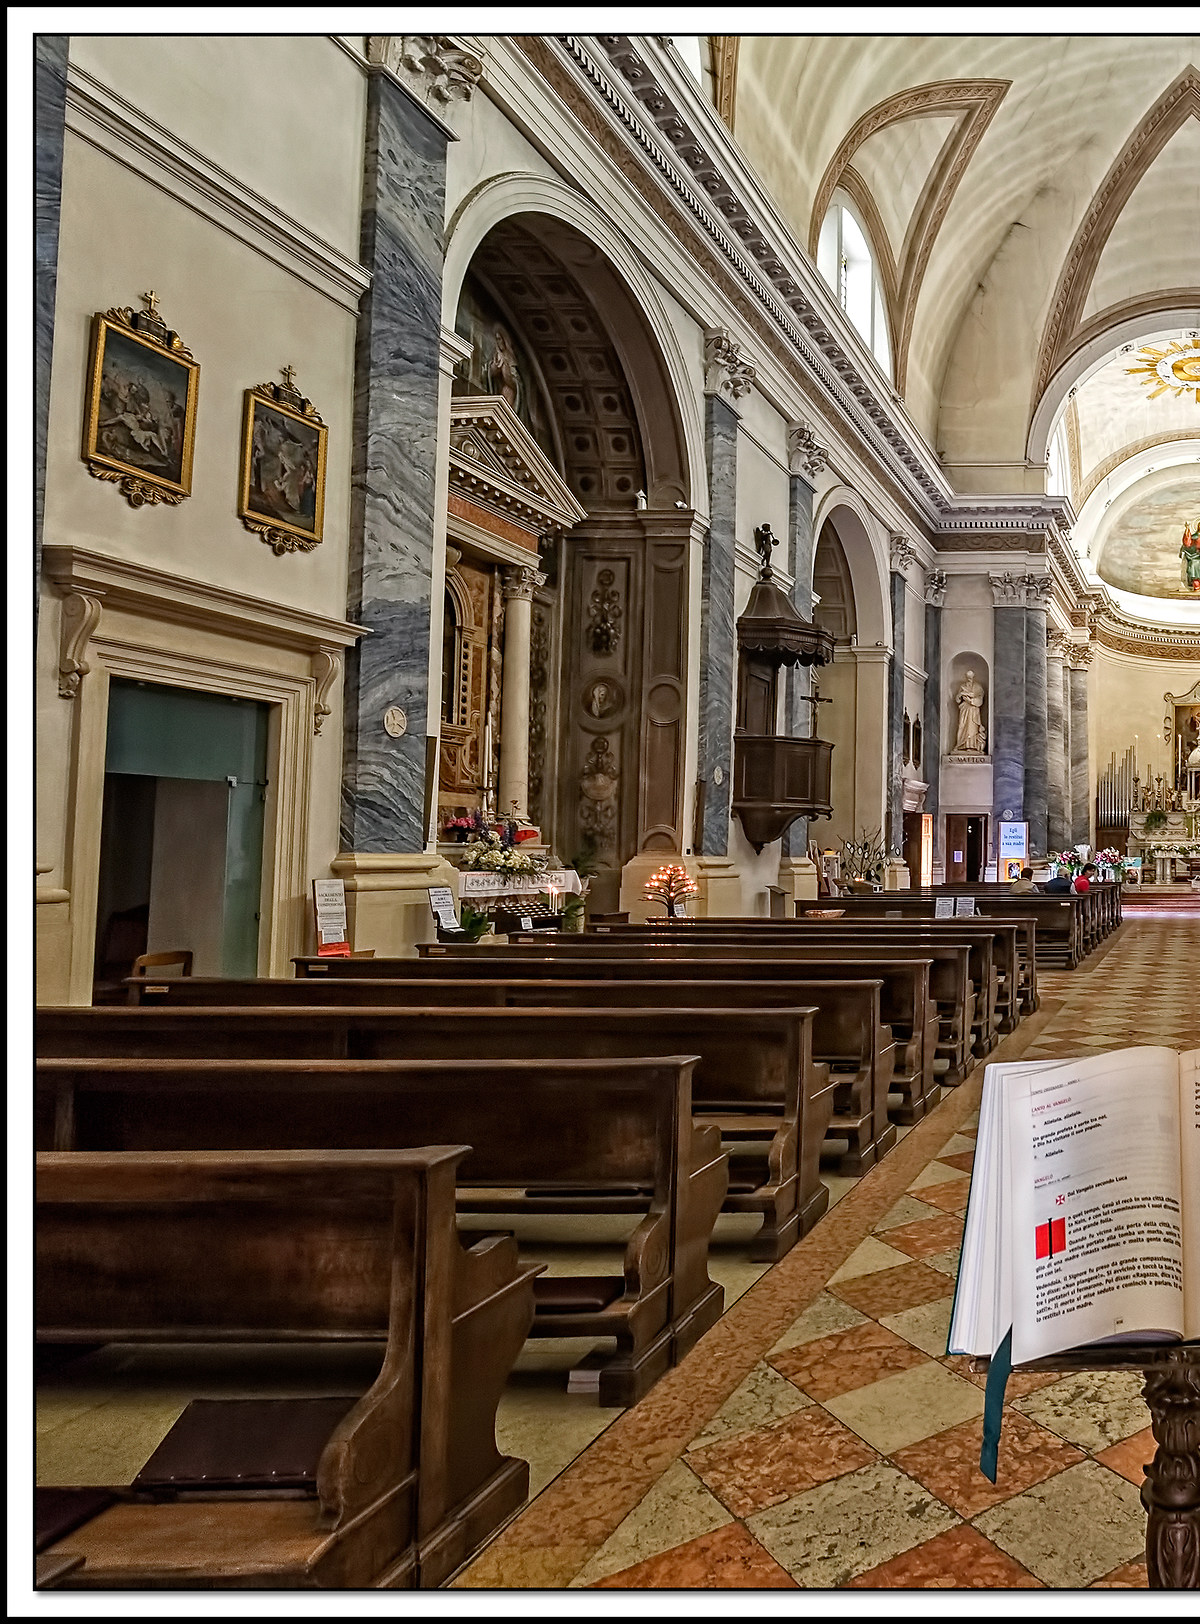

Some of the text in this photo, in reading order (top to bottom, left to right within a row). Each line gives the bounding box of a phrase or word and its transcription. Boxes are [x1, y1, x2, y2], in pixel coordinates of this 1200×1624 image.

[1057, 1125, 1073, 1135] profeta
[1053, 1133, 1070, 1142] visitato
[1076, 1184, 1094, 1193] Vangelo
[1095, 1179, 1114, 1187] secondo
[1111, 1204, 1146, 1214] camminavano
[1083, 1222, 1098, 1231] grande
[1069, 1237, 1086, 1245] Quando
[1086, 1238, 1104, 1248] portato
[1069, 1271, 1086, 1280] Signore
[1119, 1257, 1137, 1265] grande
[1097, 1286, 1114, 1295] seduto
[1048, 1292, 1069, 1303] portatori
